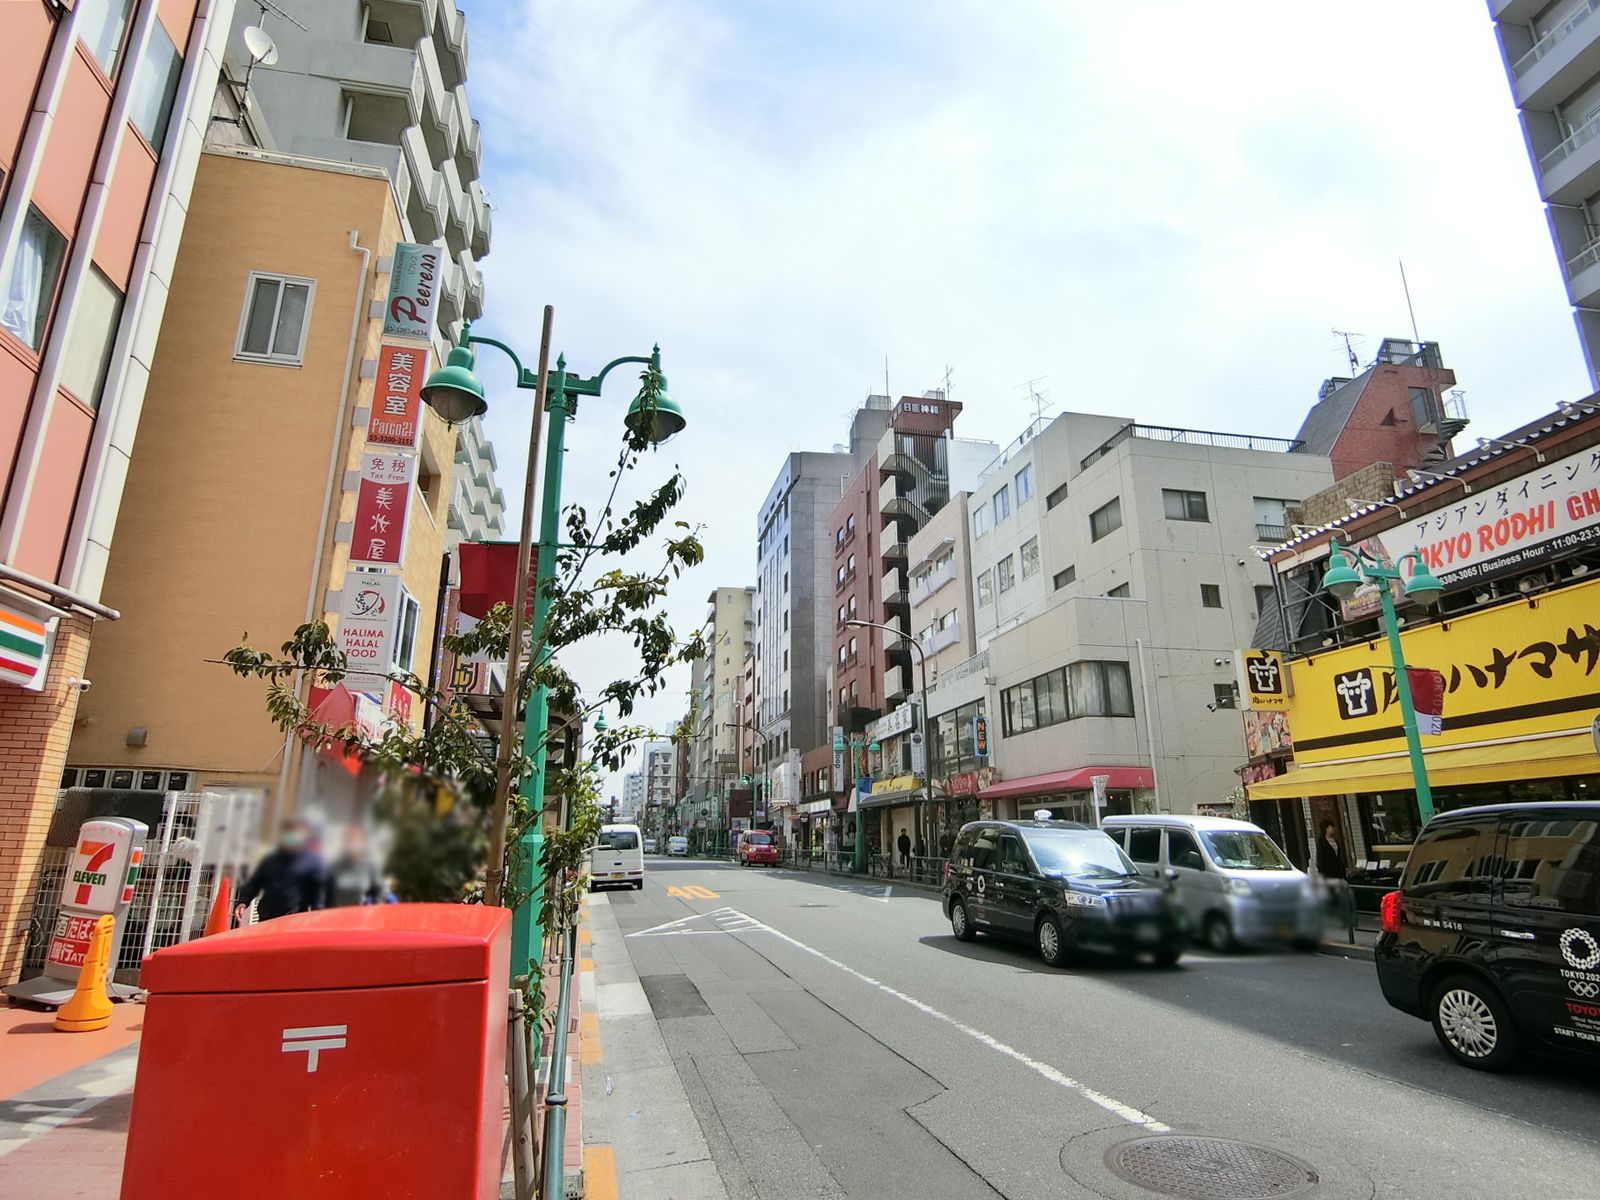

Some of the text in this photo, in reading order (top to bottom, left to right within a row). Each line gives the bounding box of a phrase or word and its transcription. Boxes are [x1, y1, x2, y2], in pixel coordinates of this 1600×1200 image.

[383, 352, 415, 416] 美容室
[371, 418, 415, 437] Parco21
[388, 473, 405, 481] Free
[1406, 532, 1473, 578] TOKYO
[1477, 500, 1555, 553] RODHI
[1482, 553, 1521, 573] Business
[1522, 545, 1545, 560] Hour
[343, 628, 385, 639] HALIMA
[346, 638, 379, 649] HALAL
[346, 648, 377, 659] FOOD
[977, 722, 986, 749] NEW
[666, 886, 721, 899] 40
[1442, 920, 1462, 930] 5418
[51, 941, 86, 963] 銀行AT
[1560, 969, 1585, 980] TOKYO
[1553, 1027, 1575, 1037] START
[1575, 1031, 1596, 1041] YOUR
